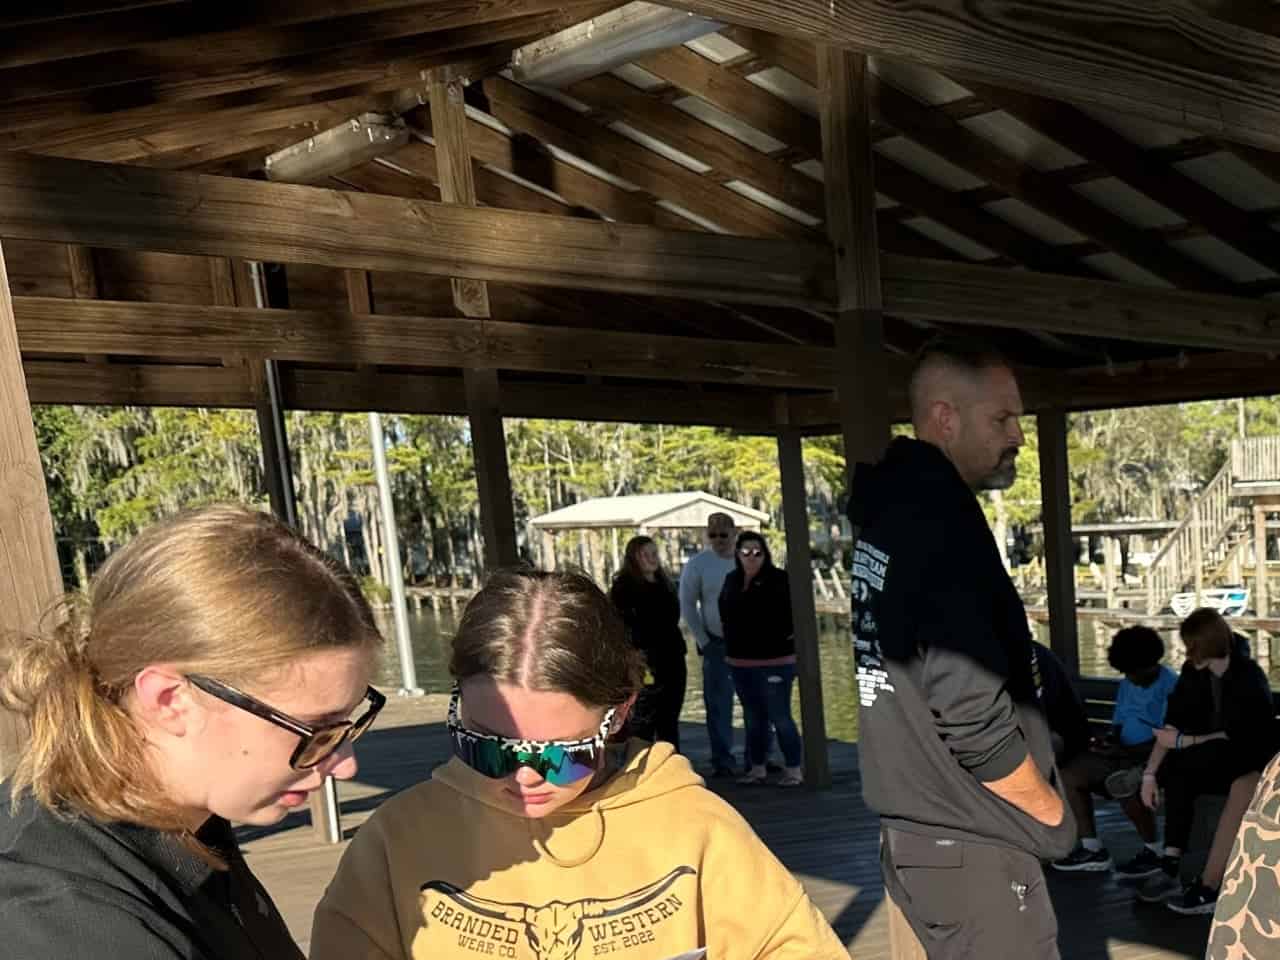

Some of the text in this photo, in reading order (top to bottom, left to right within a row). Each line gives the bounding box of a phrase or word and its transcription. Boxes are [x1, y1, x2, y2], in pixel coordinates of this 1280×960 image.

[431, 900, 519, 944] BRANDED
[587, 892, 684, 942] WESTERN
[457, 933, 497, 957] WEAR
[593, 929, 656, 956] EST. 2022
